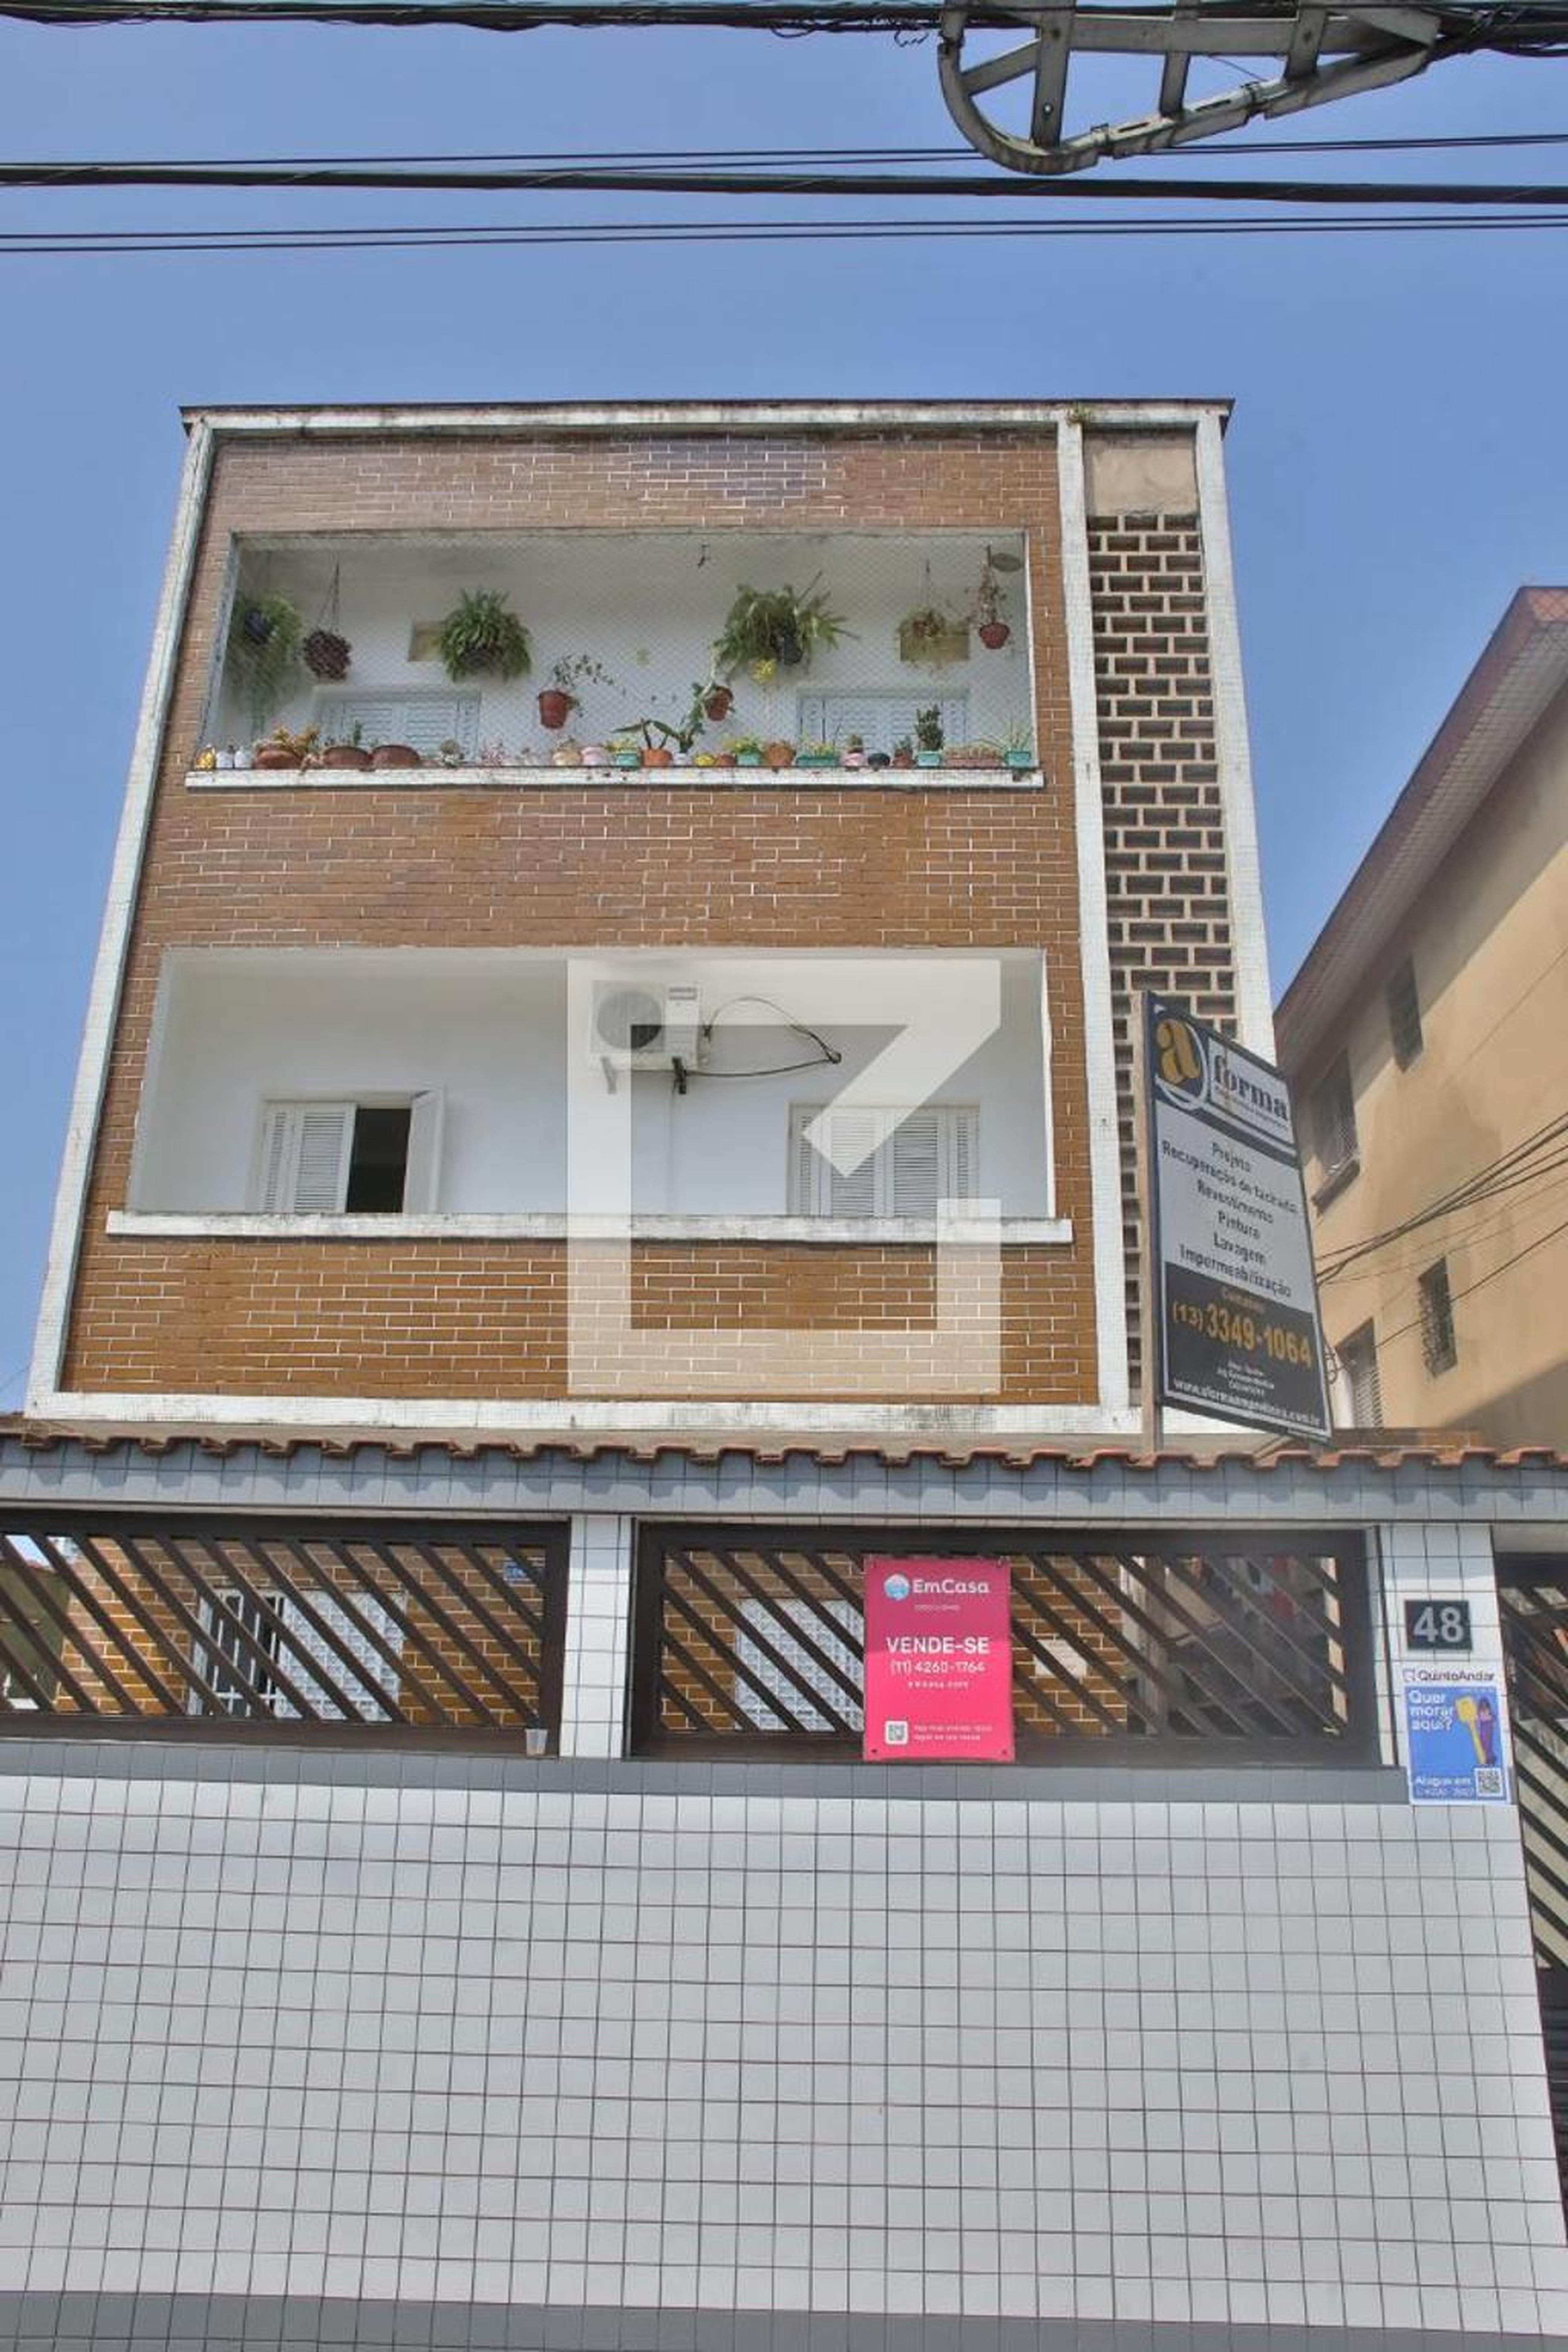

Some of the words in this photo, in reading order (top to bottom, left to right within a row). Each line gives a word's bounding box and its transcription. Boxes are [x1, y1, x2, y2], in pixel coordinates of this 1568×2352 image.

[1214, 1055, 1289, 1122] forma
[1161, 1140, 1236, 1187] Recuperação
[1212, 1143, 1251, 1173] Projeto
[1198, 1179, 1274, 1224] Revestimento
[1218, 1210, 1261, 1240] Pintura
[1213, 1232, 1266, 1264] Lavagem
[1180, 1244, 1292, 1298] Impermeabilização
[1172, 1299, 1203, 1332] (13)
[1207, 1303, 1312, 1368] 3349-1064
[912, 1578, 990, 1594] EmCasa
[1413, 1606, 1464, 1643] 48
[886, 1636, 990, 1655] VENDE-SE
[890, 1660, 912, 1675] (11)
[914, 1661, 986, 1674] 4260-1764
[1419, 1669, 1495, 1682] QuintoAndar
[1409, 1689, 1446, 1704] Quer
[1410, 1705, 1454, 1716] morar
[1411, 1716, 1453, 1732] aqui?
